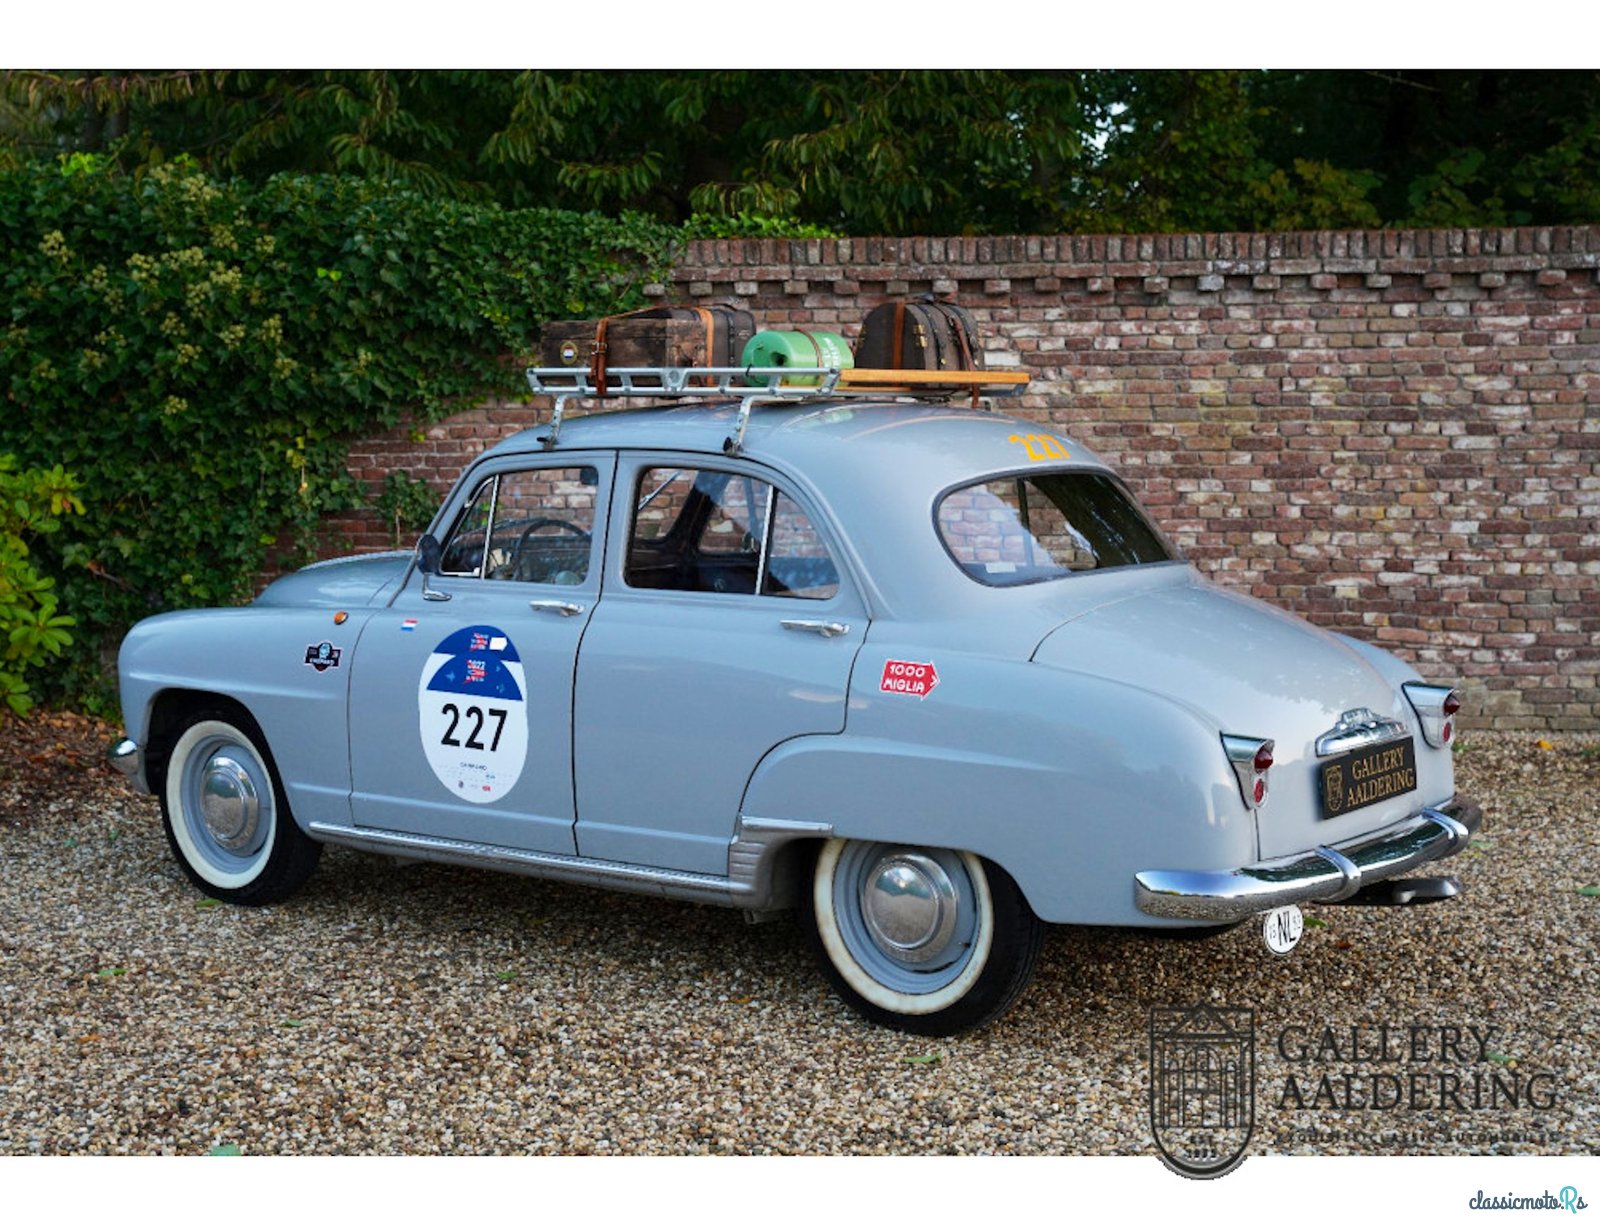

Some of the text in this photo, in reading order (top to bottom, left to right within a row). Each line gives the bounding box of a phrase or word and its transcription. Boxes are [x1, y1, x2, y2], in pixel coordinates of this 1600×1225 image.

[1008, 433, 1070, 461] 227
[882, 677, 926, 693] MIGLIA
[889, 663, 926, 679] 1000
[441, 702, 508, 753] 227
[1351, 746, 1405, 780] GALLERY
[1347, 767, 1415, 807] AALDERING
[1277, 910, 1297, 947] NL
